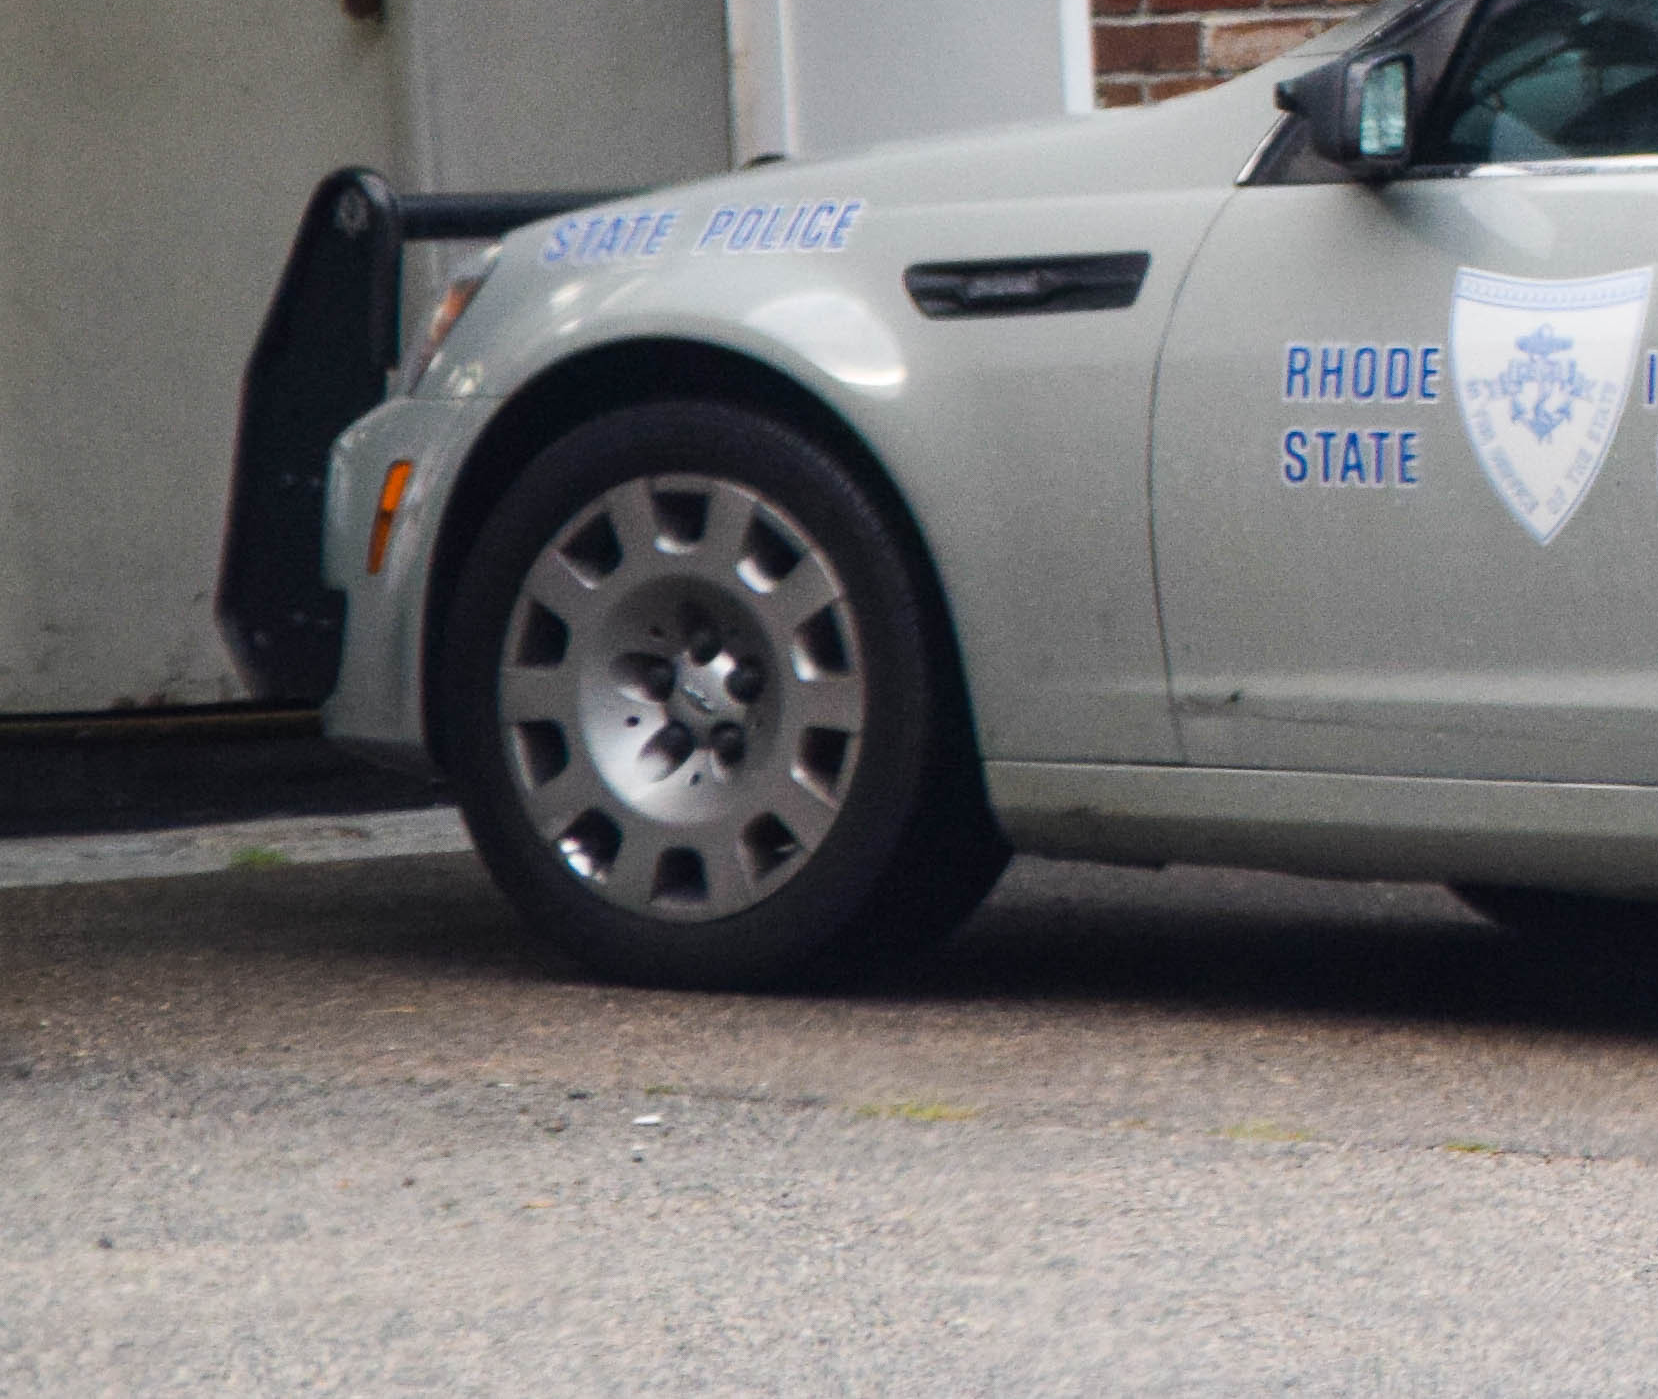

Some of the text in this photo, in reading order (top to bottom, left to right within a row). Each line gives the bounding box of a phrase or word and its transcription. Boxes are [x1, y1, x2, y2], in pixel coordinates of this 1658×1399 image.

[545, 201, 861, 261] STATE POLICE
[1285, 346, 1441, 400] RHODE
[1283, 430, 1419, 484] STATE
